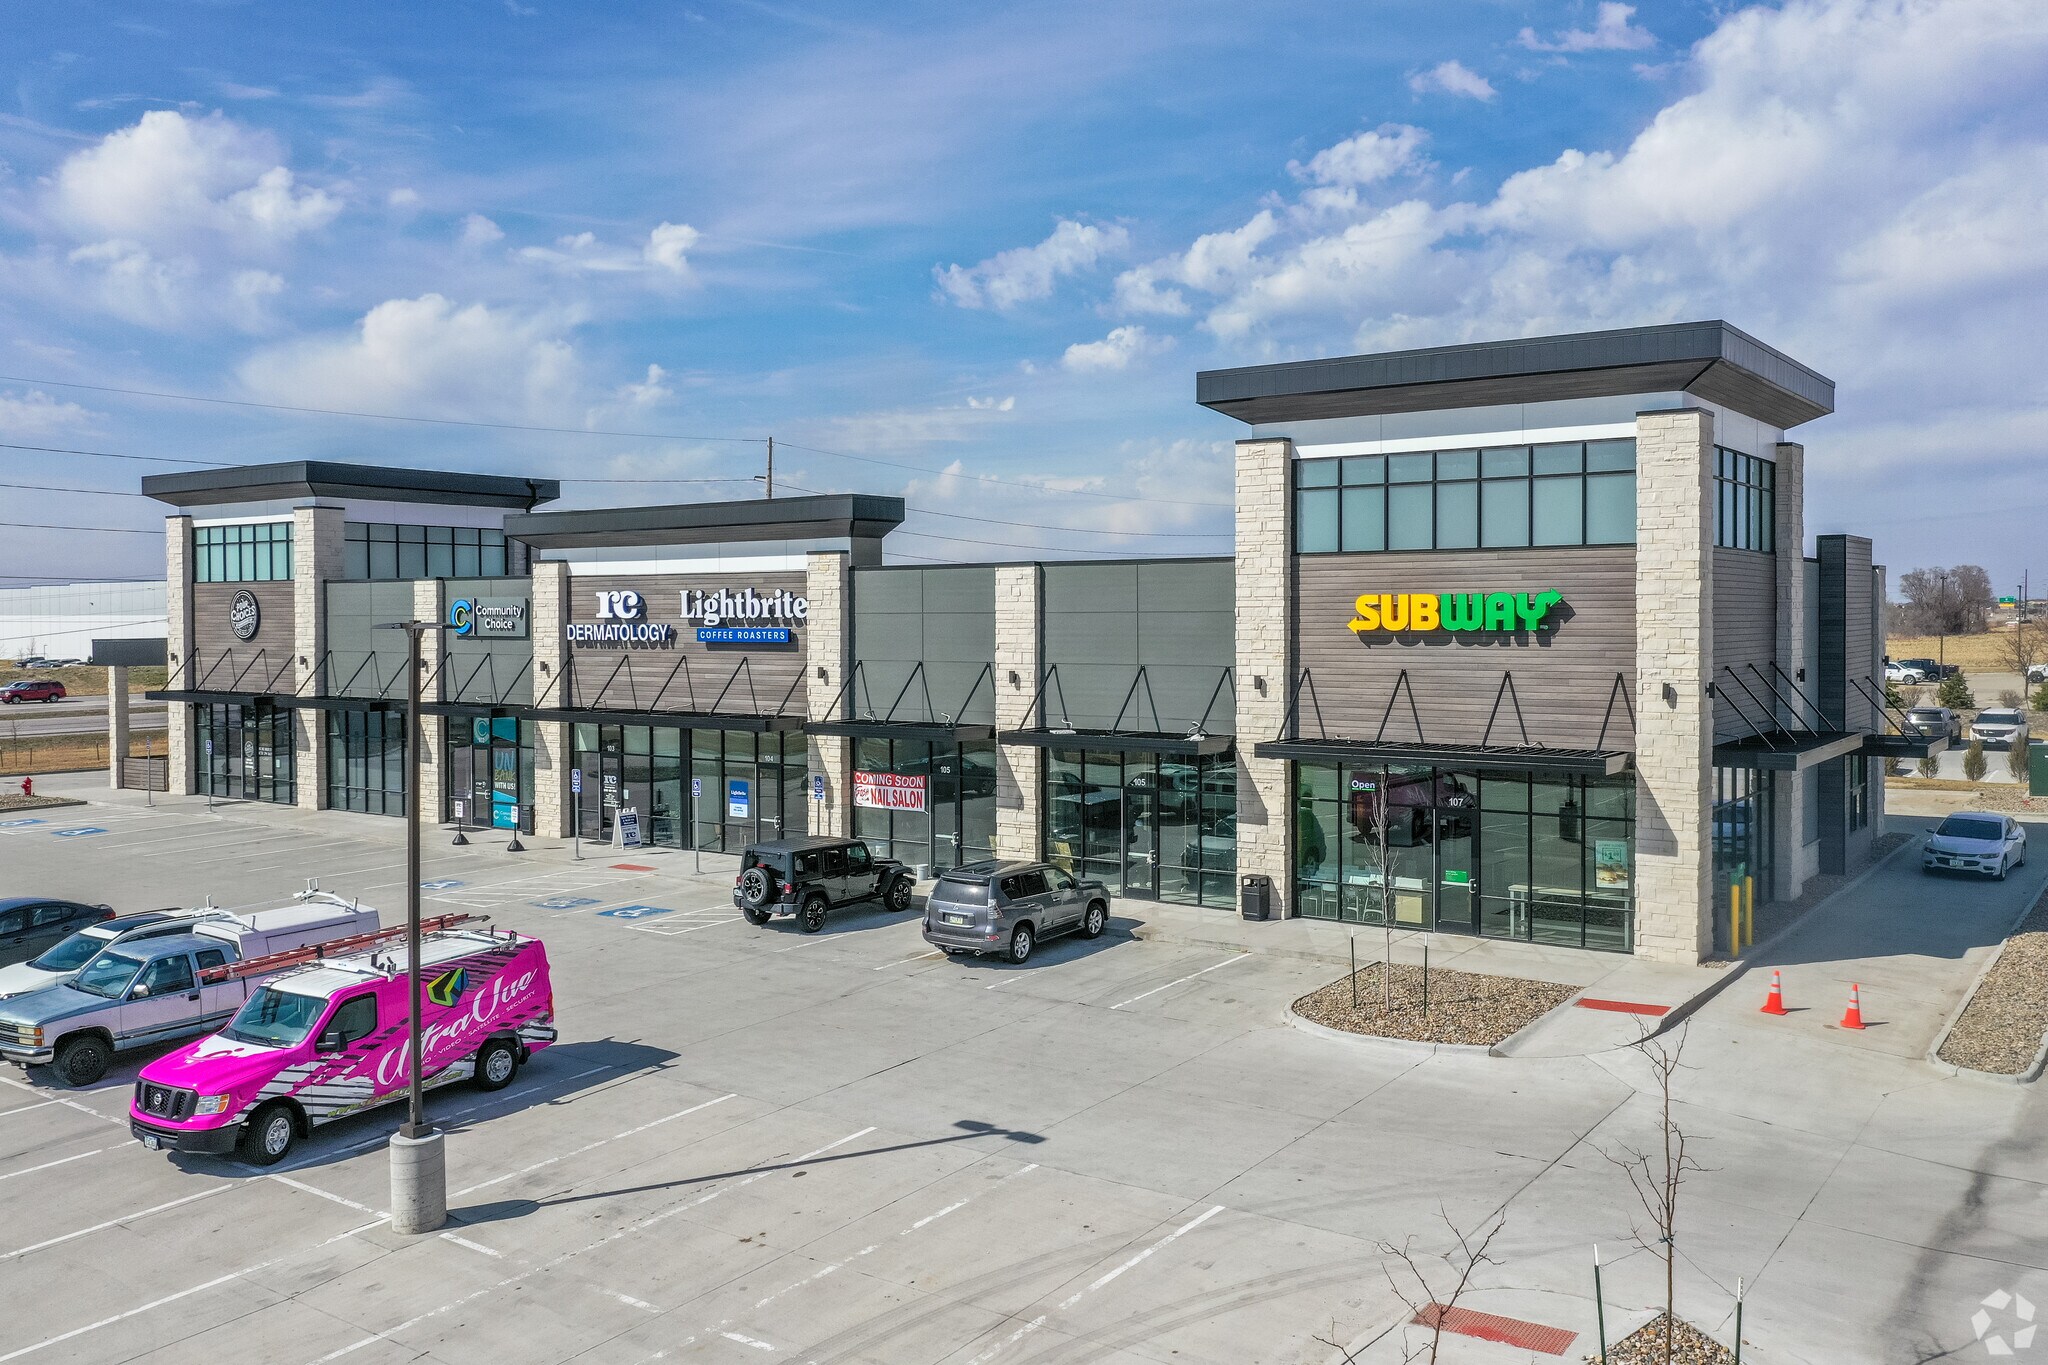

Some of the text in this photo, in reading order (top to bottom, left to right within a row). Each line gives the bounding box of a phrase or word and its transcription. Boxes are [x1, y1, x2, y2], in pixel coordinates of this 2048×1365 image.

[476, 605, 522, 618] Community
[680, 588, 808, 626] Lightbrite
[1347, 588, 1563, 632] SUBWAY
[484, 618, 513, 629] Choice
[566, 624, 668, 641] DERMATOLOGY
[700, 630, 785, 640] COFFEE ROASTERS
[495, 751, 515, 770] UN
[940, 766, 951, 774] 105
[494, 781, 506, 790] WITH
[854, 772, 924, 788] COMING SOON
[1351, 780, 1376, 789] Open
[871, 788, 891, 807] NAIL
[892, 789, 923, 809] SALON
[1448, 797, 1464, 807] 107
[438, 990, 536, 1054] VIDEO SATELLITE SECURITY
